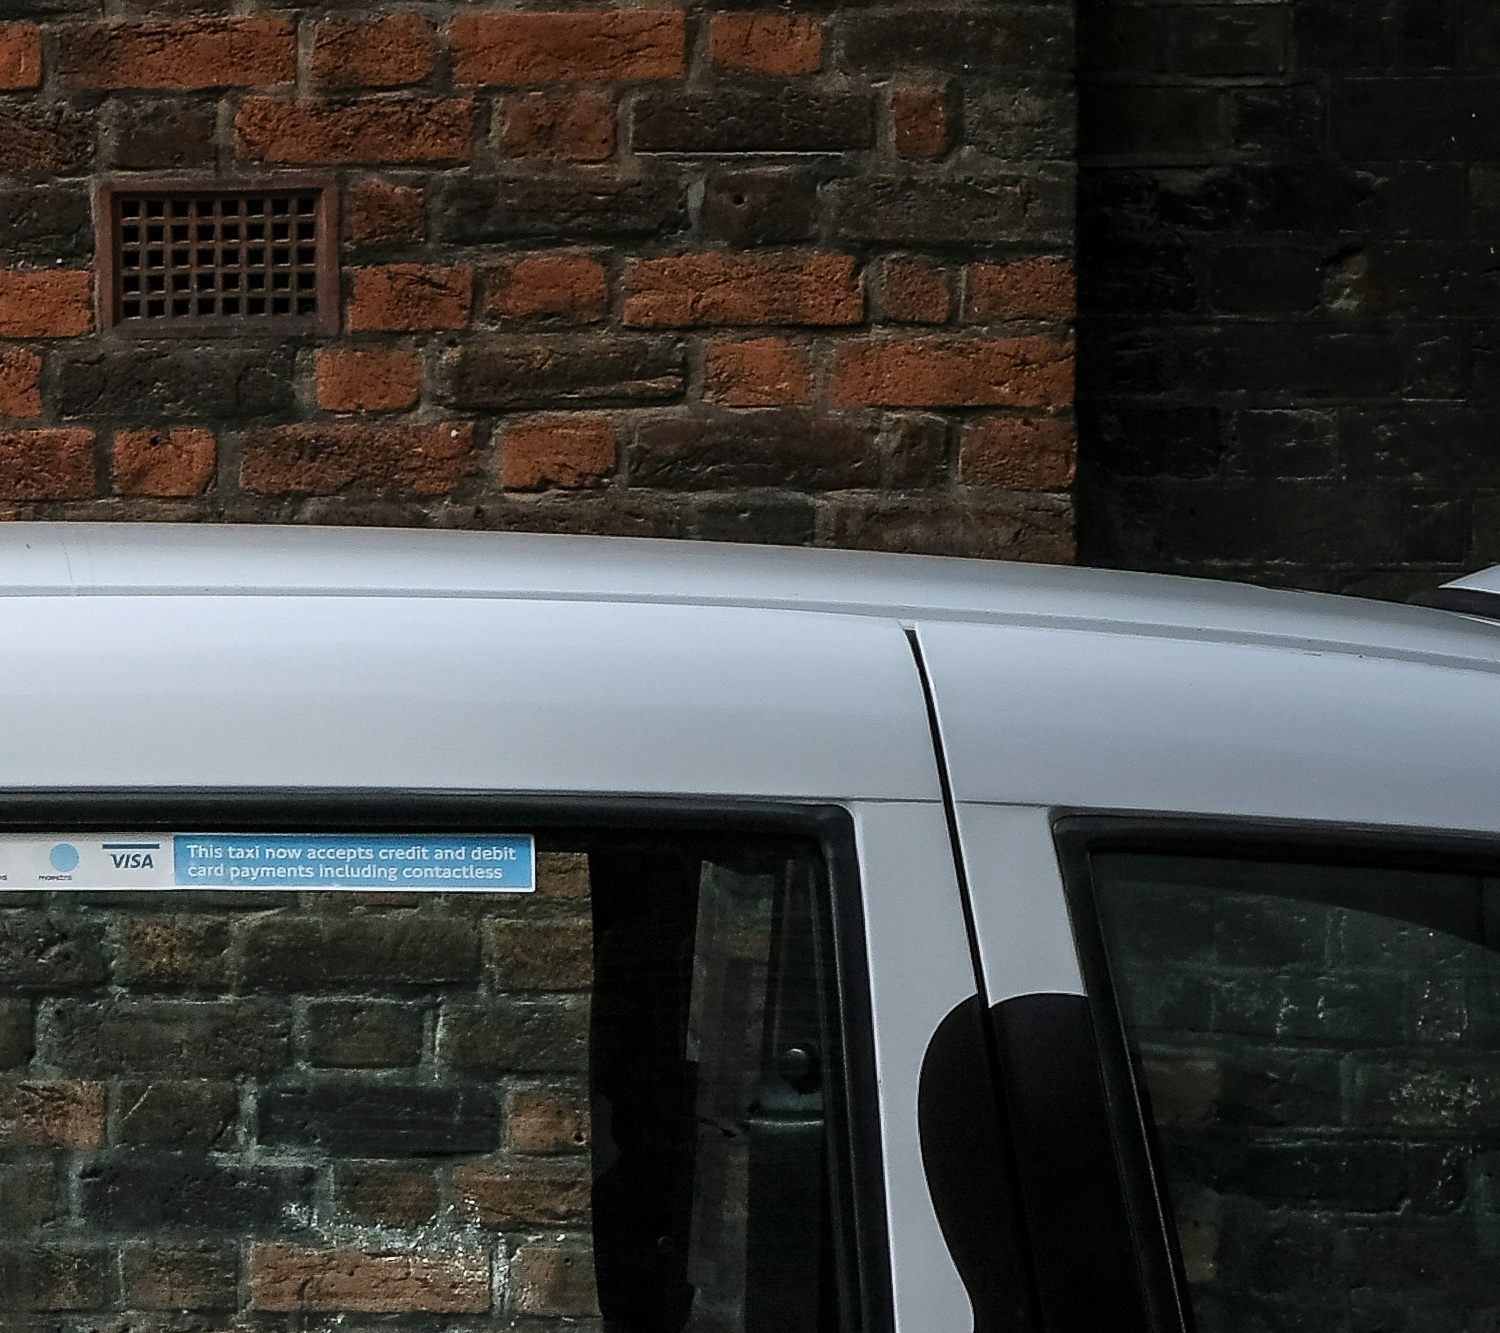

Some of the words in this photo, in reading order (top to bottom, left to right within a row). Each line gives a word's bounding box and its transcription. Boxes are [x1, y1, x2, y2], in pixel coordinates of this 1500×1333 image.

[111, 854, 155, 869] VISA
[187, 844, 223, 860] This
[227, 845, 260, 860] taxi
[265, 847, 302, 860] now
[307, 846, 374, 863] accepts
[378, 845, 429, 860] credit
[434, 846, 466, 860] and
[471, 846, 517, 861] debit
[187, 863, 224, 877] card
[230, 864, 315, 881] payments
[320, 864, 398, 881] including
[402, 865, 503, 880] contactless
